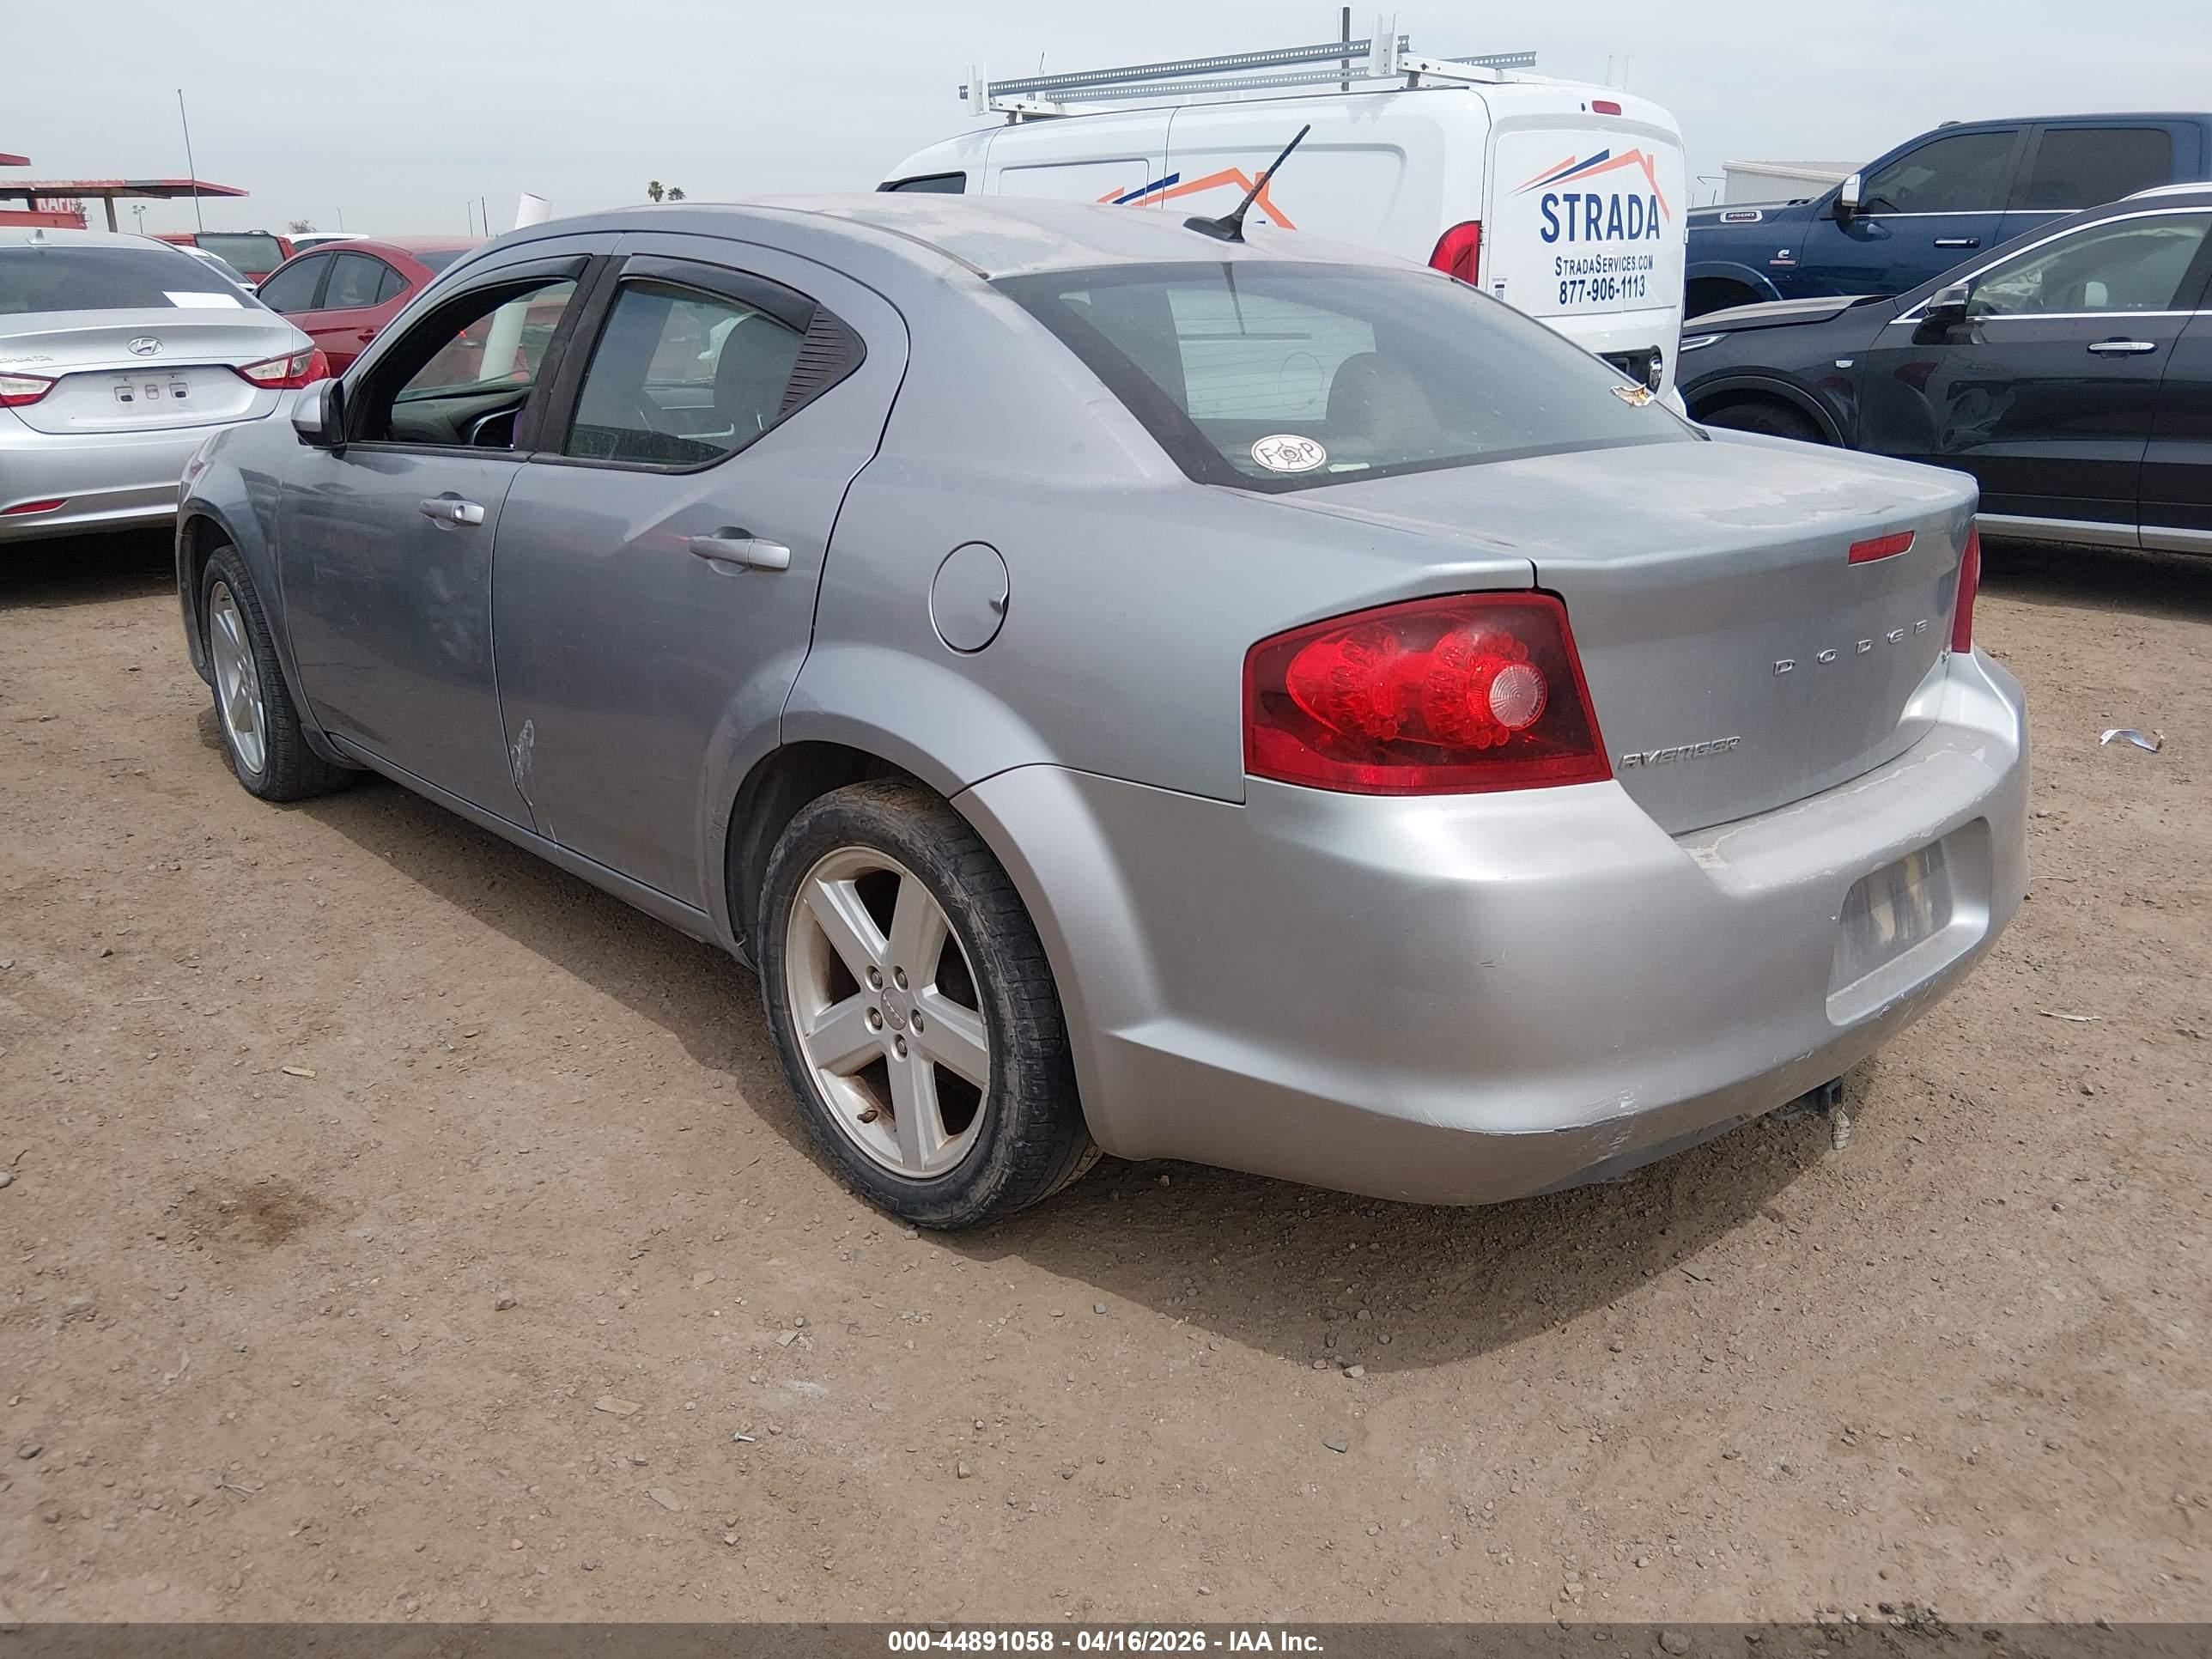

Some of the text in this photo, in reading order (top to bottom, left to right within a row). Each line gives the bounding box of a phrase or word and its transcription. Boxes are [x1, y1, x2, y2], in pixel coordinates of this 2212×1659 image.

[1540, 193, 1661, 244] STRADA
[1559, 275, 1646, 305] 877-906-1113
[1773, 619, 1928, 676] DODGE
[1618, 736, 1742, 770] AVENGER
